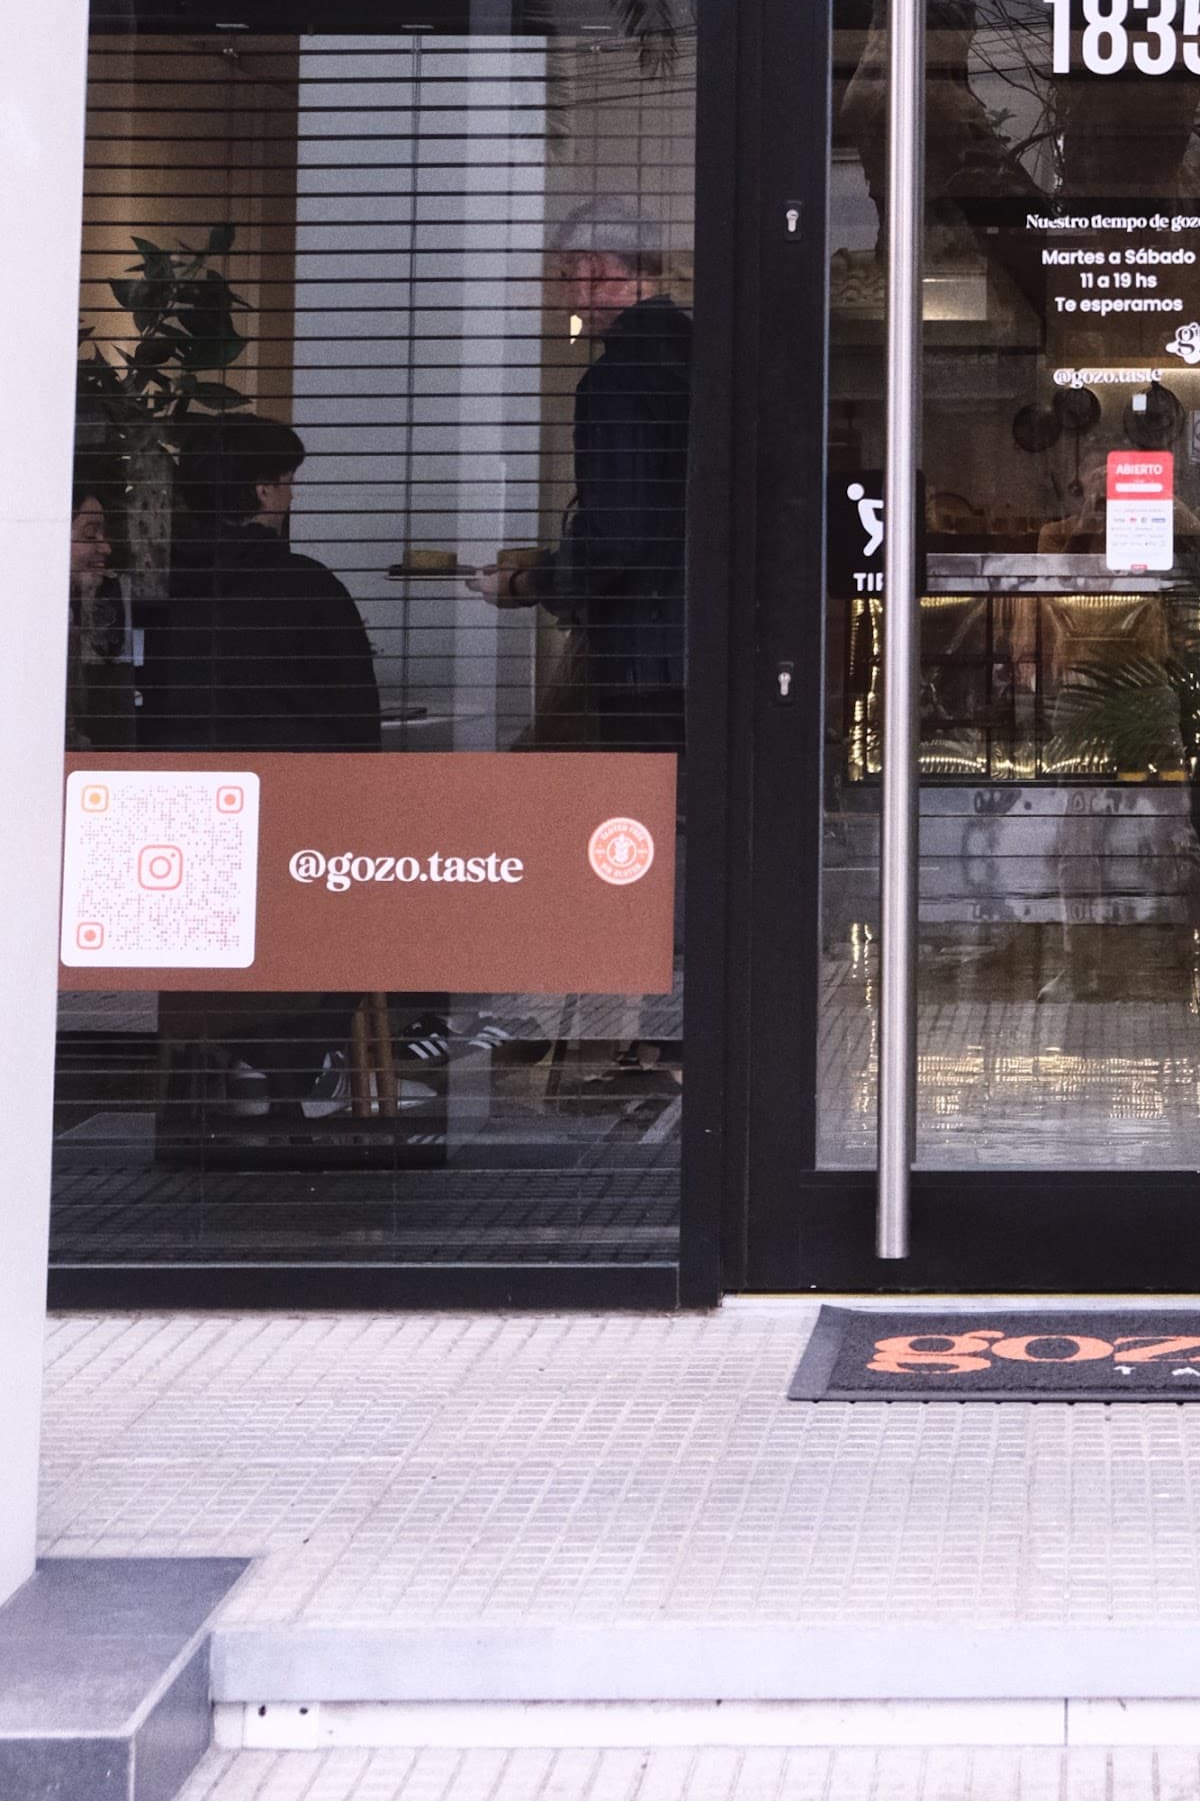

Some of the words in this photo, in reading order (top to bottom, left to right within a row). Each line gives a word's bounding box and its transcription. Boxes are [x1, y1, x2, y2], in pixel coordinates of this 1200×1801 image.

[1026, 213, 1089, 229] Nuestro
[1090, 213, 1147, 233] tiempo
[1149, 212, 1169, 229] de
[1041, 249, 1105, 265] Martes
[1108, 252, 1121, 265] a
[1124, 247, 1197, 265] Sábado
[1079, 272, 1094, 289] 11
[1096, 275, 1110, 289] a
[1113, 272, 1132, 289] 19
[1135, 272, 1158, 289] hs
[1054, 296, 1077, 312] Te
[1079, 298, 1184, 317] esperamos
[1115, 463, 1164, 476] ABIERTO
[289, 849, 524, 892] @gozo.taste
